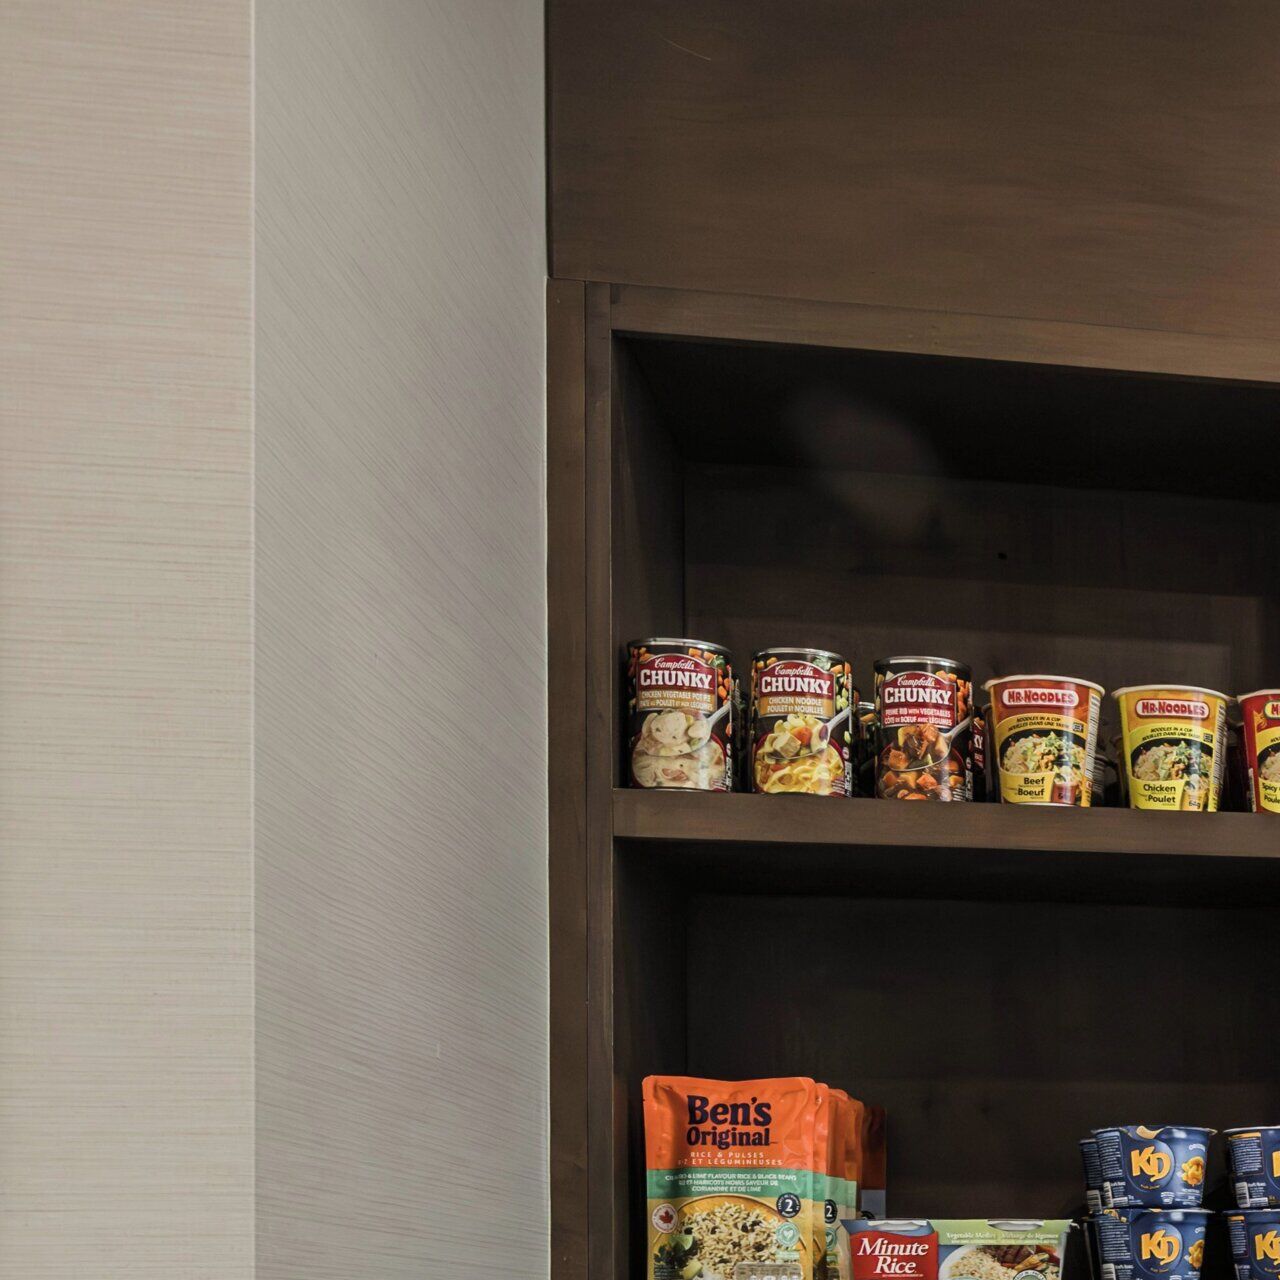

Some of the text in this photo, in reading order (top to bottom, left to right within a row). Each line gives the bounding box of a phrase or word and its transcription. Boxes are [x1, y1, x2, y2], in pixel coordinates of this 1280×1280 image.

[641, 669, 712, 689] CHUNKY
[762, 676, 830, 694] CHUNKY
[885, 687, 952, 705] CHUNKY
[1024, 690, 1074, 704] NOODLES
[1158, 702, 1205, 716] NOODLES
[1024, 777, 1045, 785] Beef
[1143, 783, 1176, 792] Chicken
[1262, 782, 1278, 792] Spicy
[1018, 788, 1045, 796] Boeuf
[1148, 795, 1175, 803] Poulet
[686, 1094, 772, 1126] Ben's
[686, 1126, 771, 1150] Original
[1130, 1146, 1172, 1183] KD
[785, 1200, 792, 1212] 2
[826, 1206, 833, 1217] 2
[857, 1237, 929, 1256] Minute
[1141, 1229, 1180, 1266] KD
[873, 1256, 917, 1274] Rice
